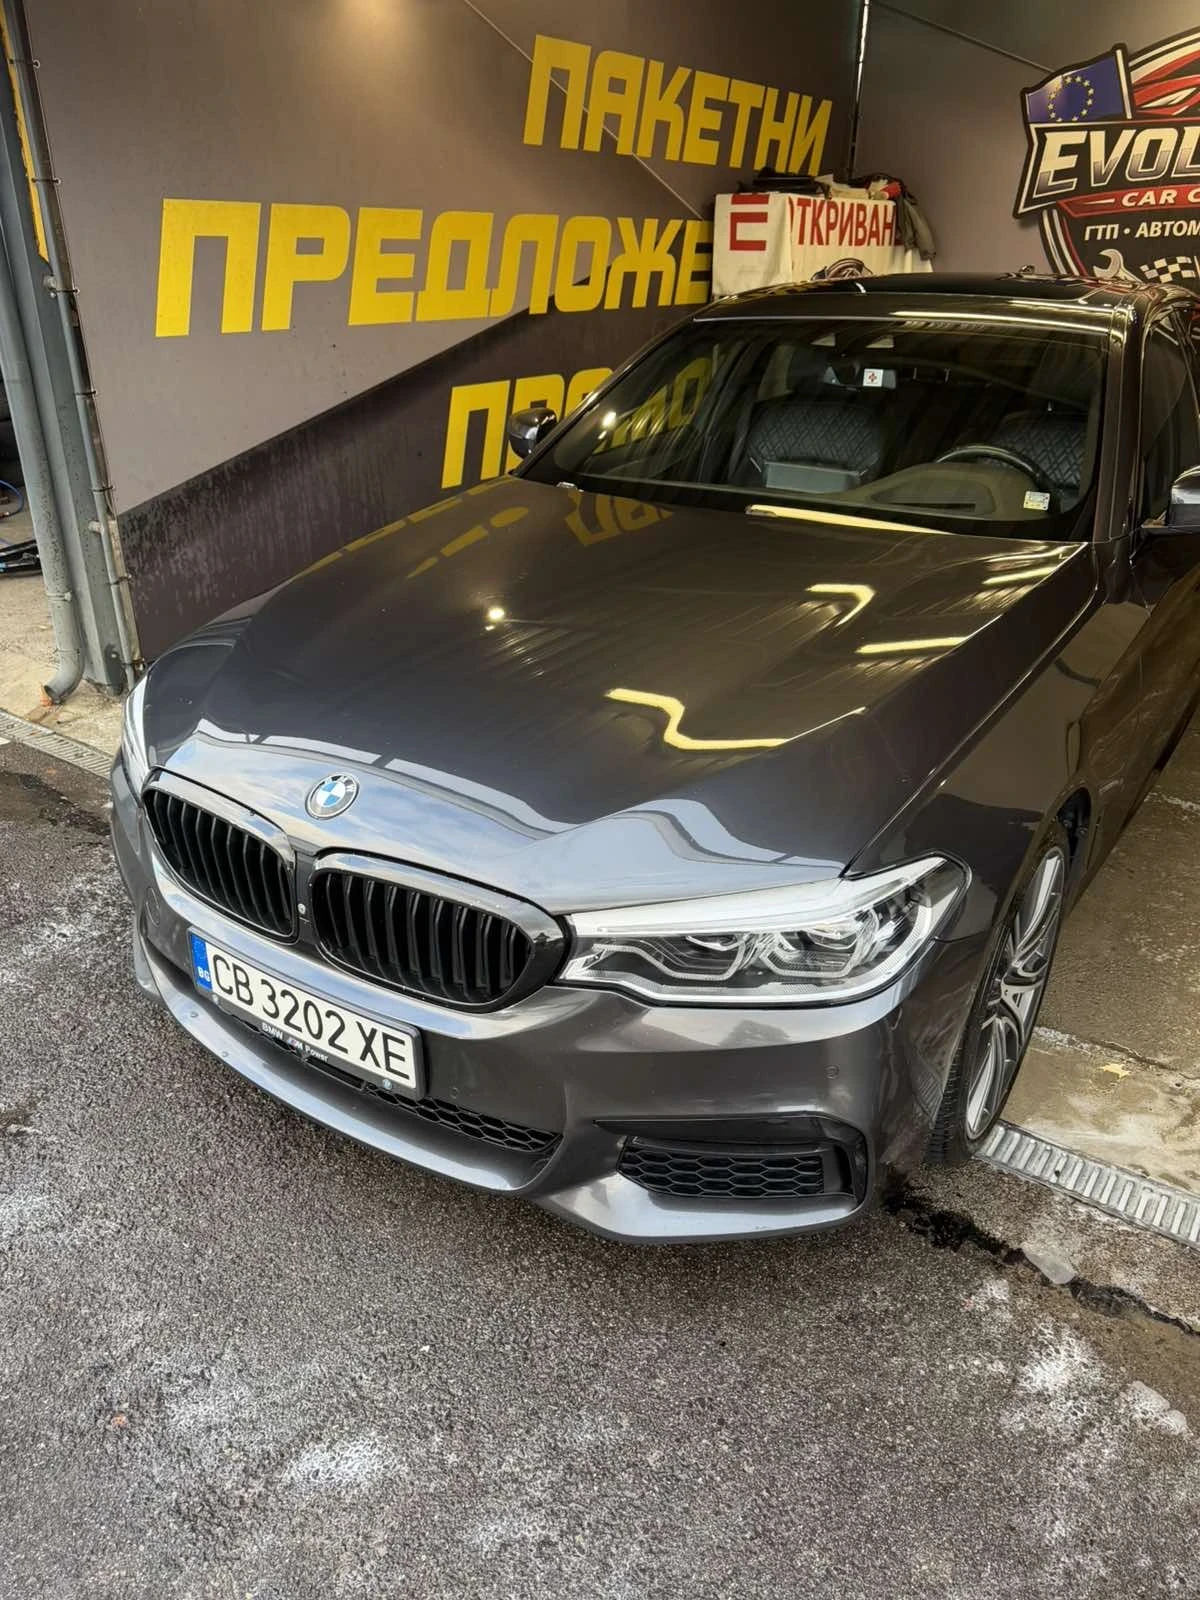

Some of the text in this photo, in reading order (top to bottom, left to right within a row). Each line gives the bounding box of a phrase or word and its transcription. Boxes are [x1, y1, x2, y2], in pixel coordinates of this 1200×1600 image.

[523, 34, 832, 176] ПАКЕТНИ
[1121, 189, 1177, 207] CAR
[788, 196, 904, 247] ТКРИВАН
[1084, 222, 1120, 241] ГТП
[198, 966, 211, 982] BG
[212, 954, 410, 1080] CB 3202 XE
[261, 1021, 284, 1040] BMW
[305, 1046, 328, 1062] Power
